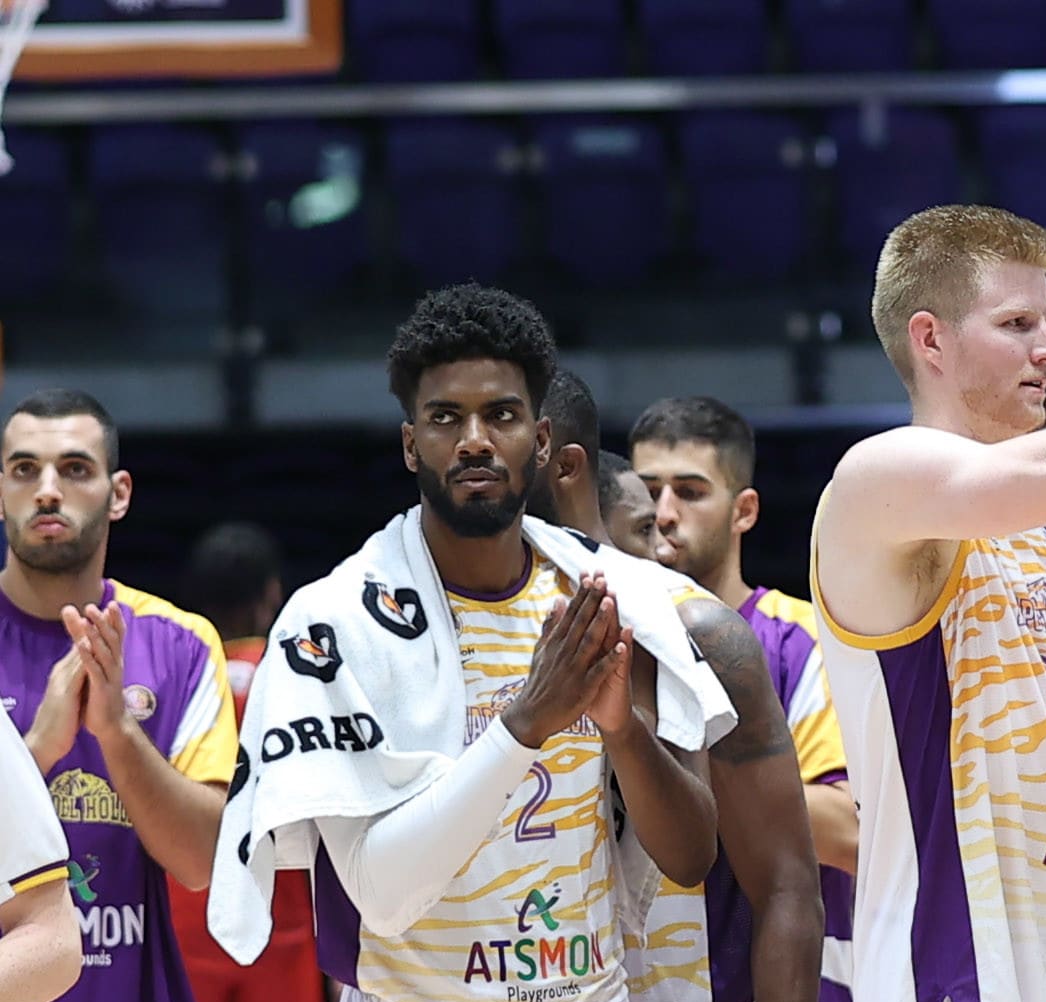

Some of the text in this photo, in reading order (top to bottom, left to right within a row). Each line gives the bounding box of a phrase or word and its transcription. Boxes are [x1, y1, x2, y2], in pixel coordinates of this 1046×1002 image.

[261, 712, 385, 763] ORAD
[515, 760, 556, 843] 2
[74, 904, 144, 947] MON
[463, 931, 605, 984] ATSMON
